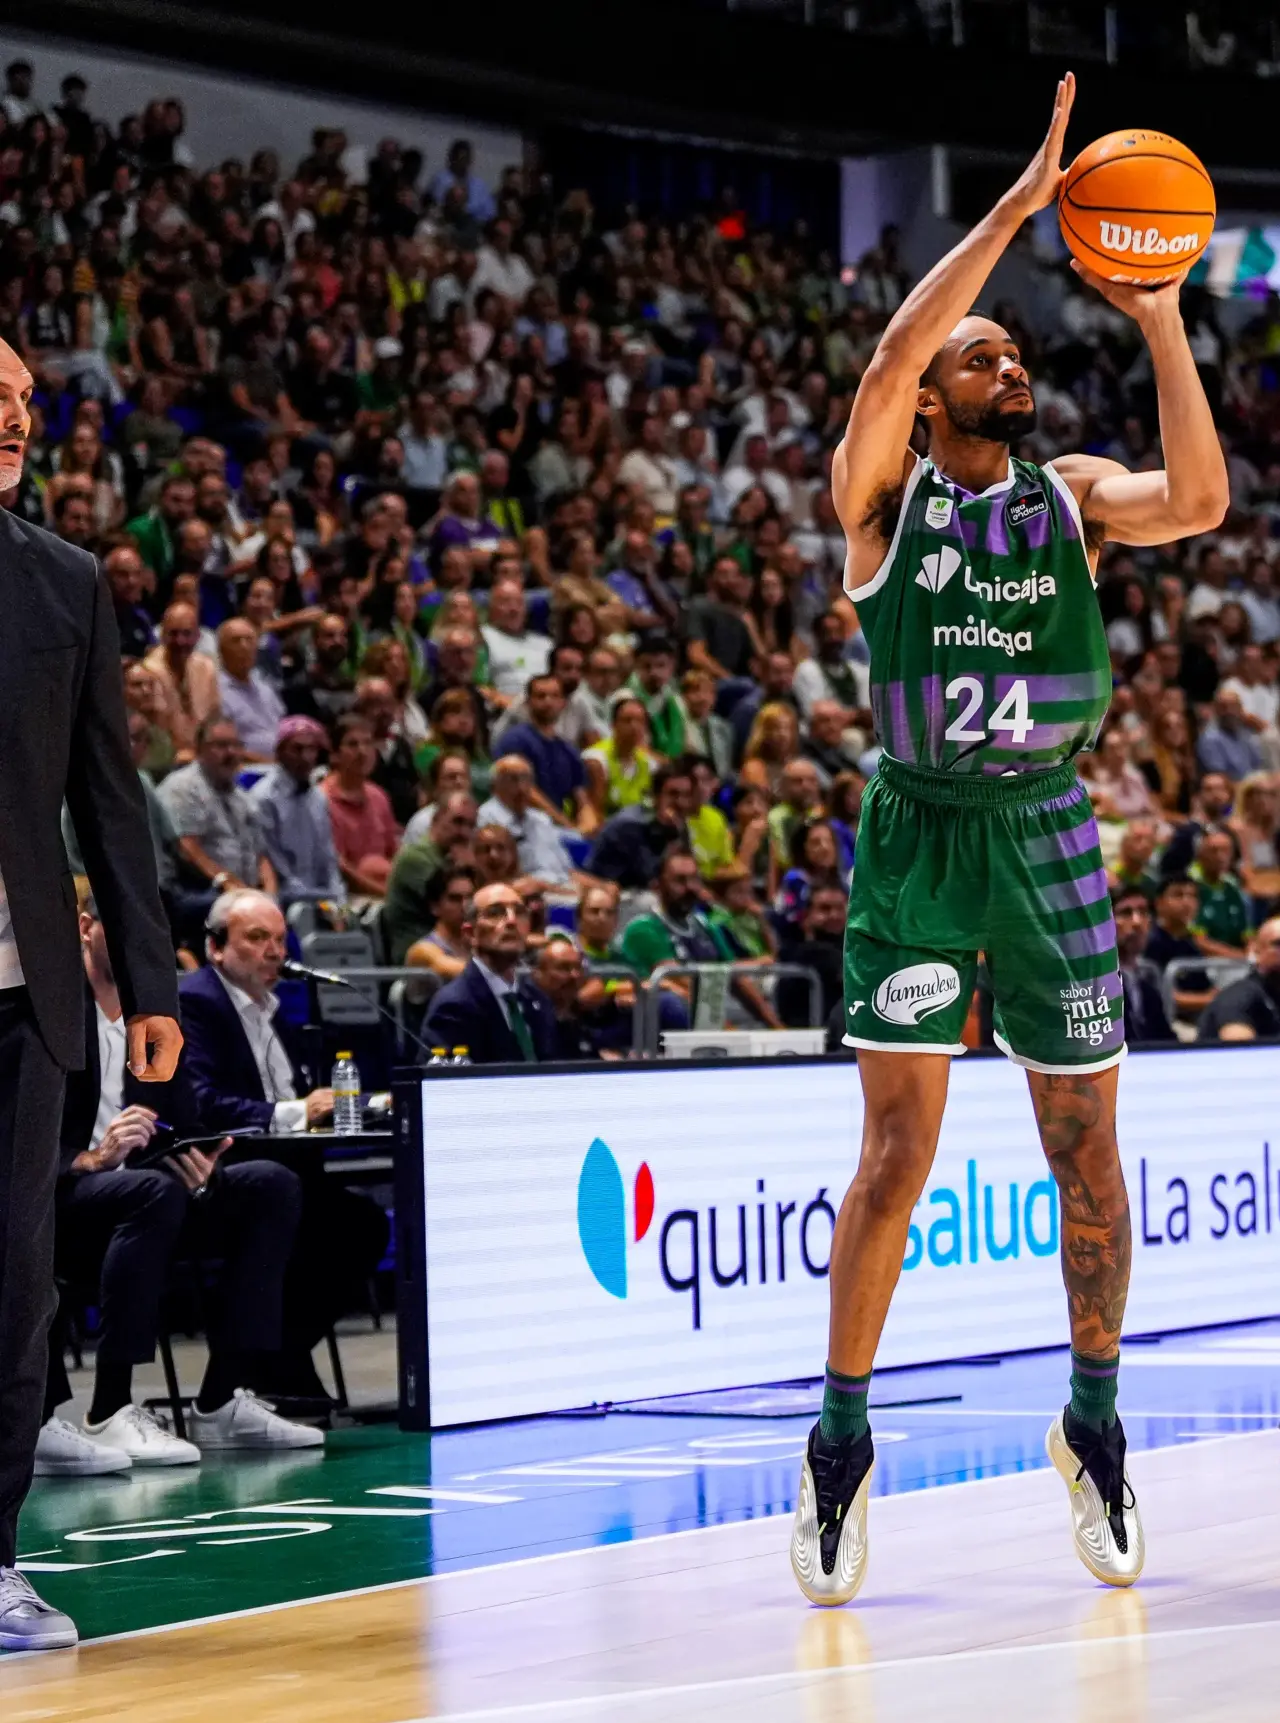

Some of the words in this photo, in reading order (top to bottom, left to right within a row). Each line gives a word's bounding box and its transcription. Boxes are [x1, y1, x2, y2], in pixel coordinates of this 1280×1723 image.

[1100, 219, 1199, 255] Wilson
[1010, 504, 1026, 514] liga
[1012, 502, 1045, 521] endesa
[964, 566, 1056, 604] Unicaja
[945, 676, 1034, 743] 24
[881, 968, 956, 1012] famadesa
[1060, 984, 1093, 999] sabor
[1139, 1157, 1190, 1246] La
